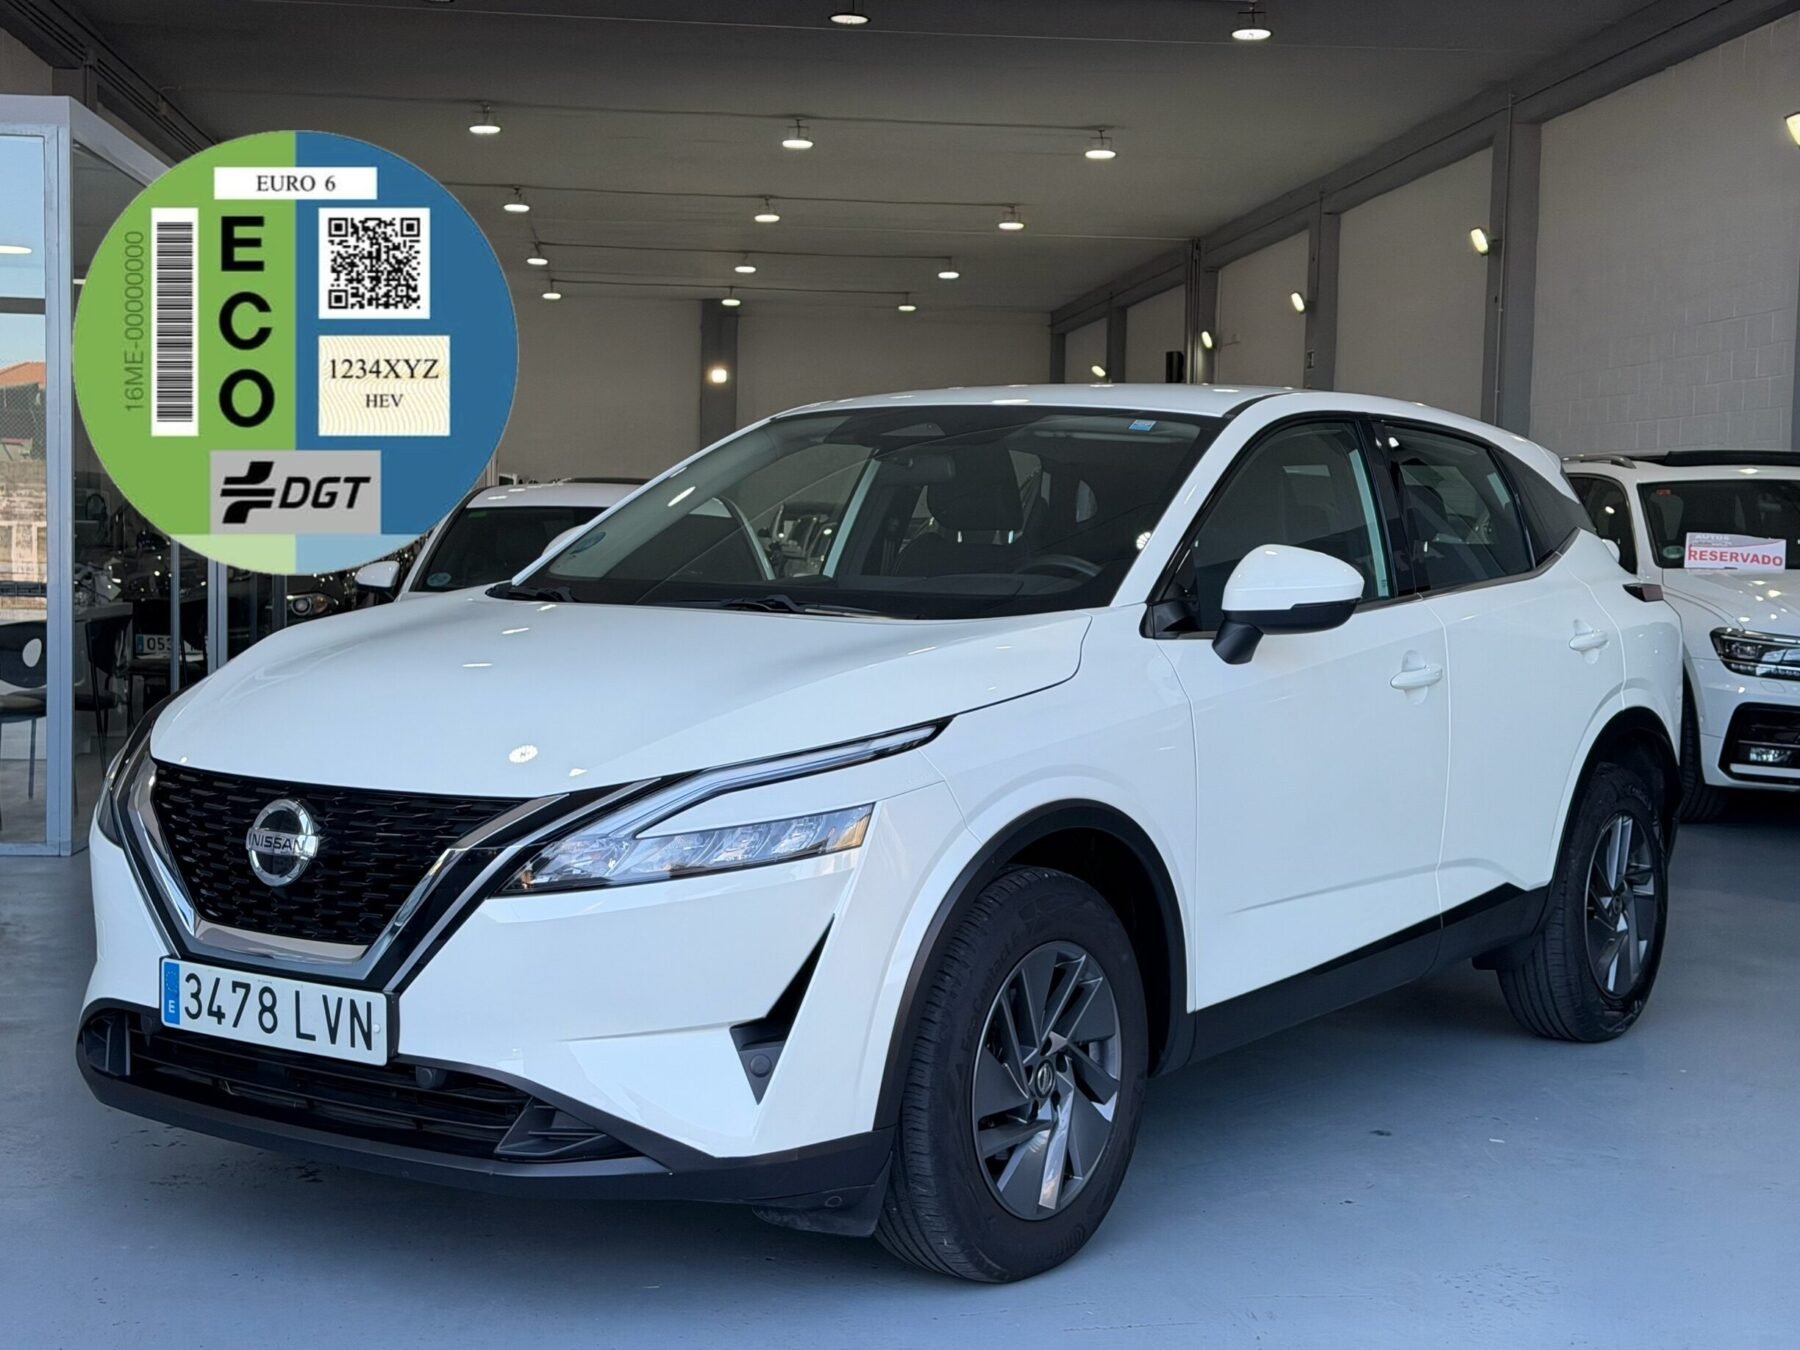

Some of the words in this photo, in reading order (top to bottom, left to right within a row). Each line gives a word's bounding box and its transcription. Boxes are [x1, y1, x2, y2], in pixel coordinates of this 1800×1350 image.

[1687, 549, 1783, 566] RESERVADO
[252, 833, 305, 851] NISSAN
[168, 999, 176, 1014] E
[184, 972, 279, 1035] 3478
[295, 989, 373, 1051] LVN
